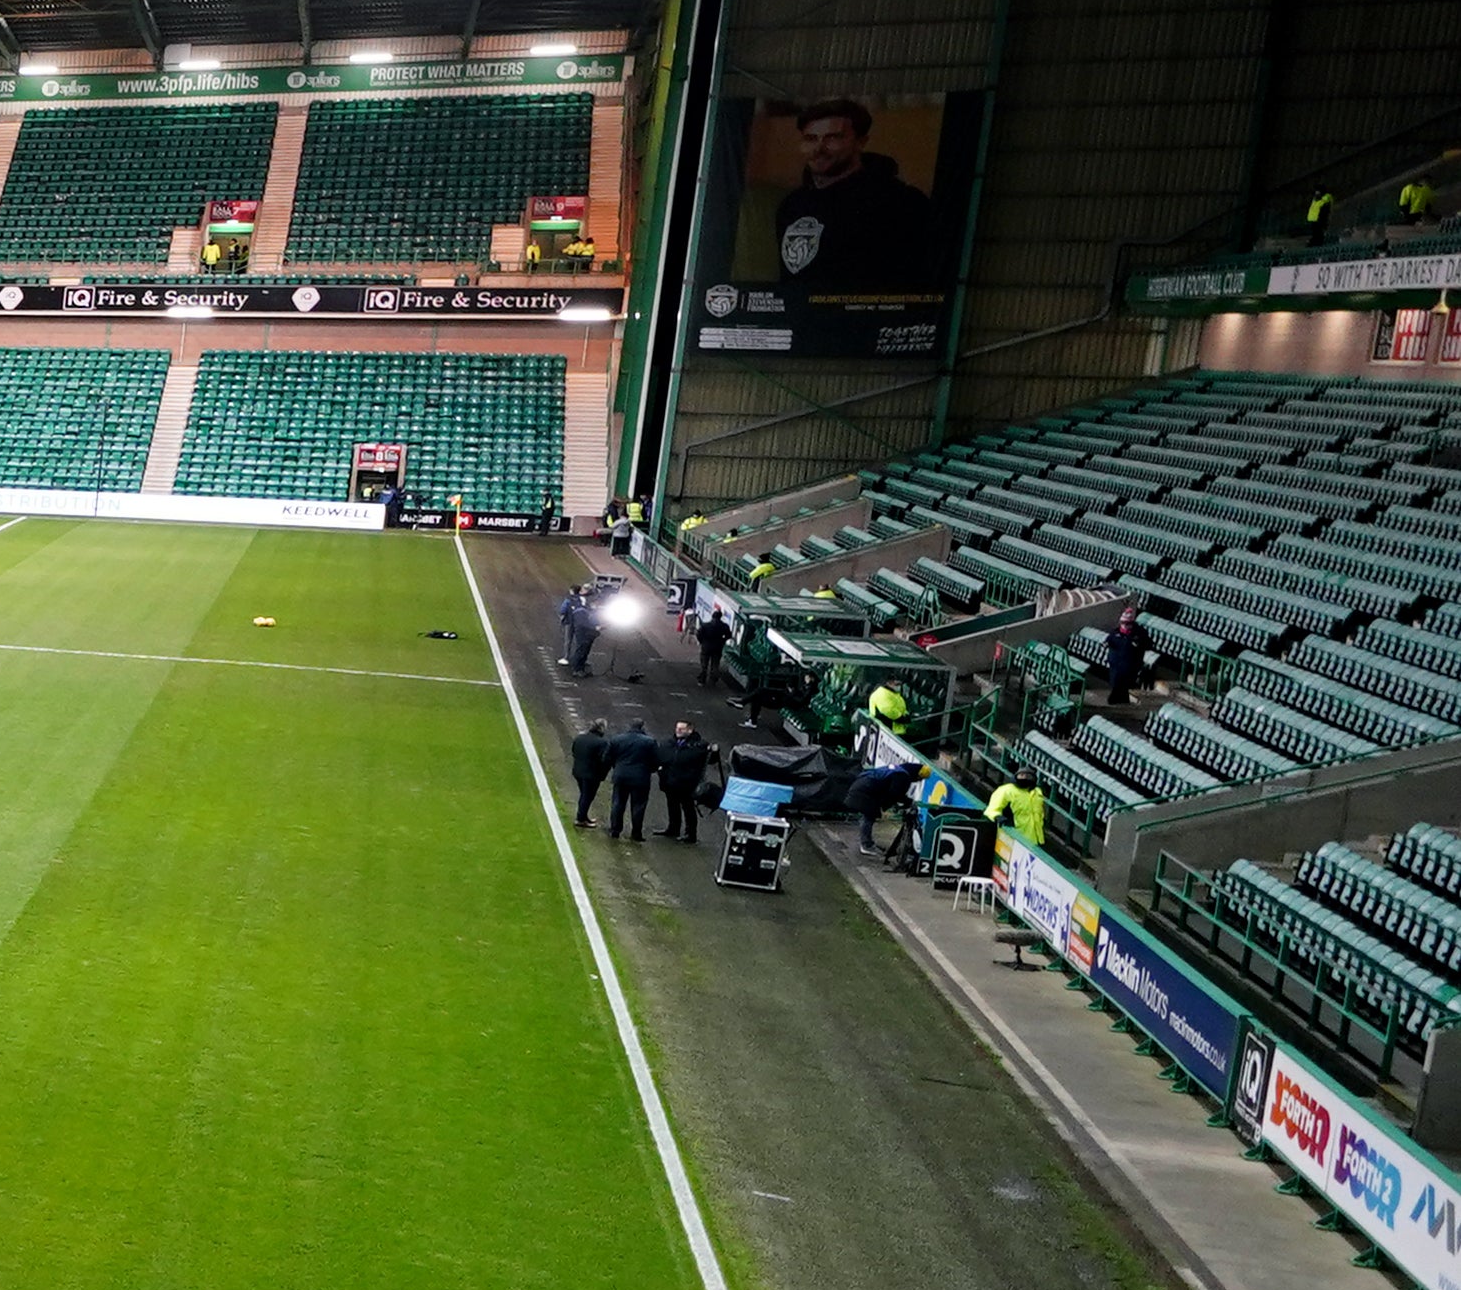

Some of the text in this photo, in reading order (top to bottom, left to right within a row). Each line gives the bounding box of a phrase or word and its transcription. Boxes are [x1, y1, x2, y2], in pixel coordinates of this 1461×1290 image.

[117, 72, 259, 94] www.3pfp.life/hibs
[370, 68, 425, 82] PROTECT
[428, 66, 464, 80] WHAT
[467, 62, 525, 78] MATTERS
[1184, 275, 1222, 296] FOOTBALL
[1222, 272, 1246, 294] CLUB
[1318, 267, 1331, 289] SO
[1333, 264, 1364, 288] WITH
[1367, 263, 1387, 287] THE
[1389, 259, 1439, 286] DARKEST
[97, 290, 137, 306] Fire
[141, 291, 159, 306] &
[164, 290, 249, 311] Security
[402, 291, 445, 308] Fire
[452, 292, 471, 308] &
[477, 291, 571, 312] Security
[282, 505, 371, 519] KEEDWELL
[477, 516, 529, 529] MARSBET
[1107, 939, 1140, 994] Macklin
[1140, 966, 1169, 1020] Motors
[1279, 1094, 1314, 1136] FORTH
[1314, 1118, 1323, 1143] 1
[1342, 1146, 1392, 1202] FORTH 2
